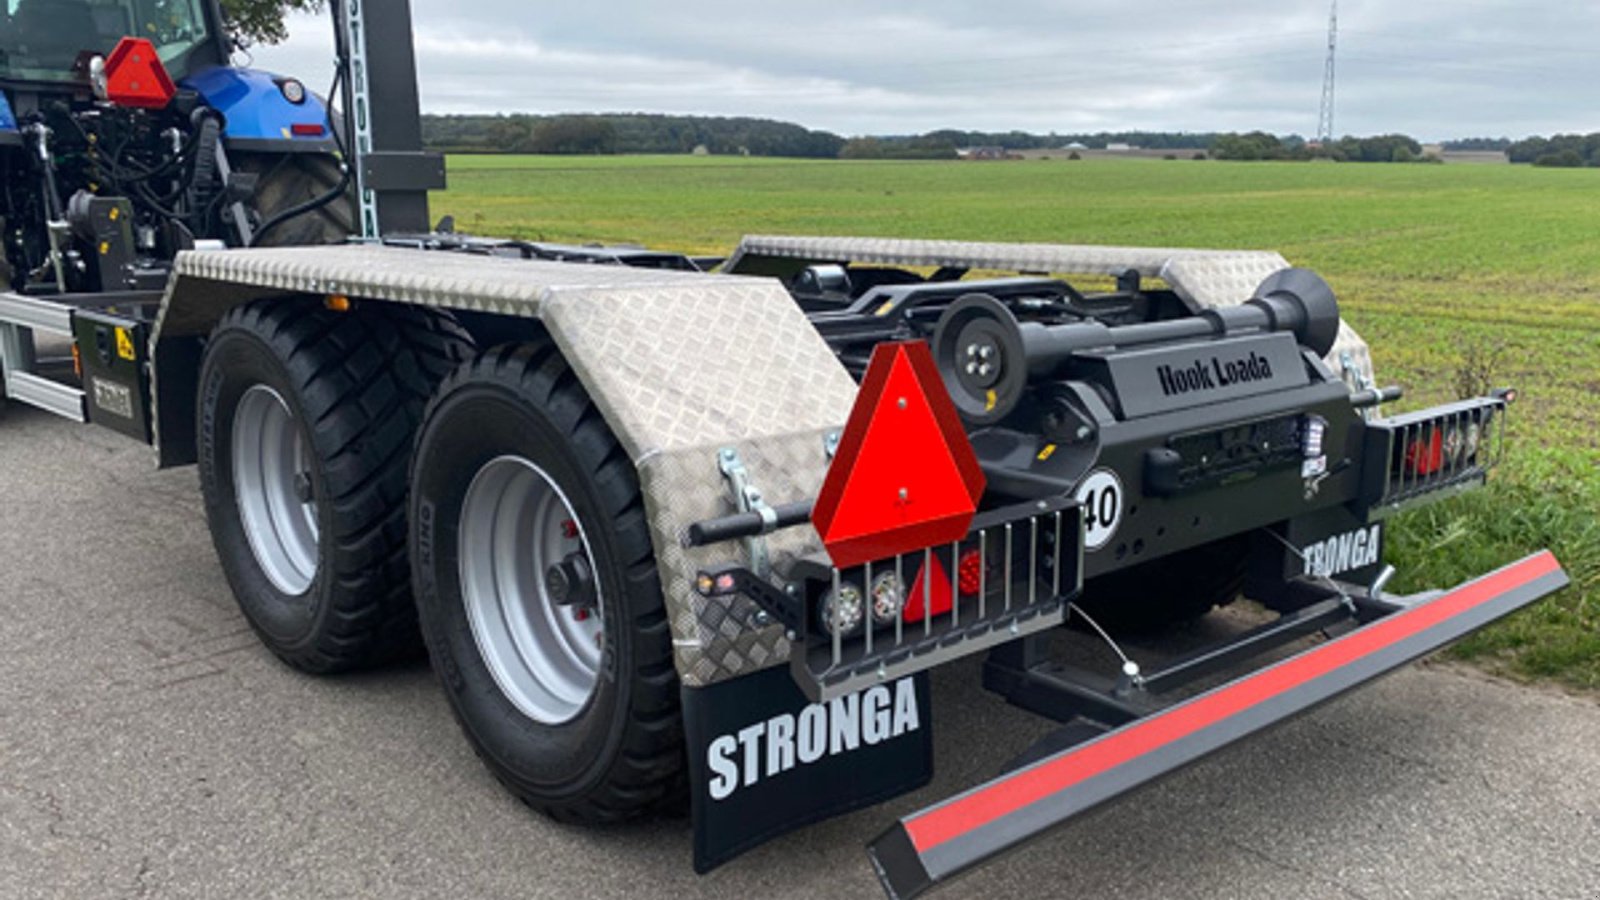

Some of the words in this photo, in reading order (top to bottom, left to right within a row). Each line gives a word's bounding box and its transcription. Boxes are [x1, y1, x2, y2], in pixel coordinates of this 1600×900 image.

[1156, 359, 1215, 396] Hook
[1211, 351, 1273, 387] Loada
[1084, 485, 1116, 531] 40
[1303, 524, 1380, 578] TRONGA
[707, 676, 920, 800] STRONGA
